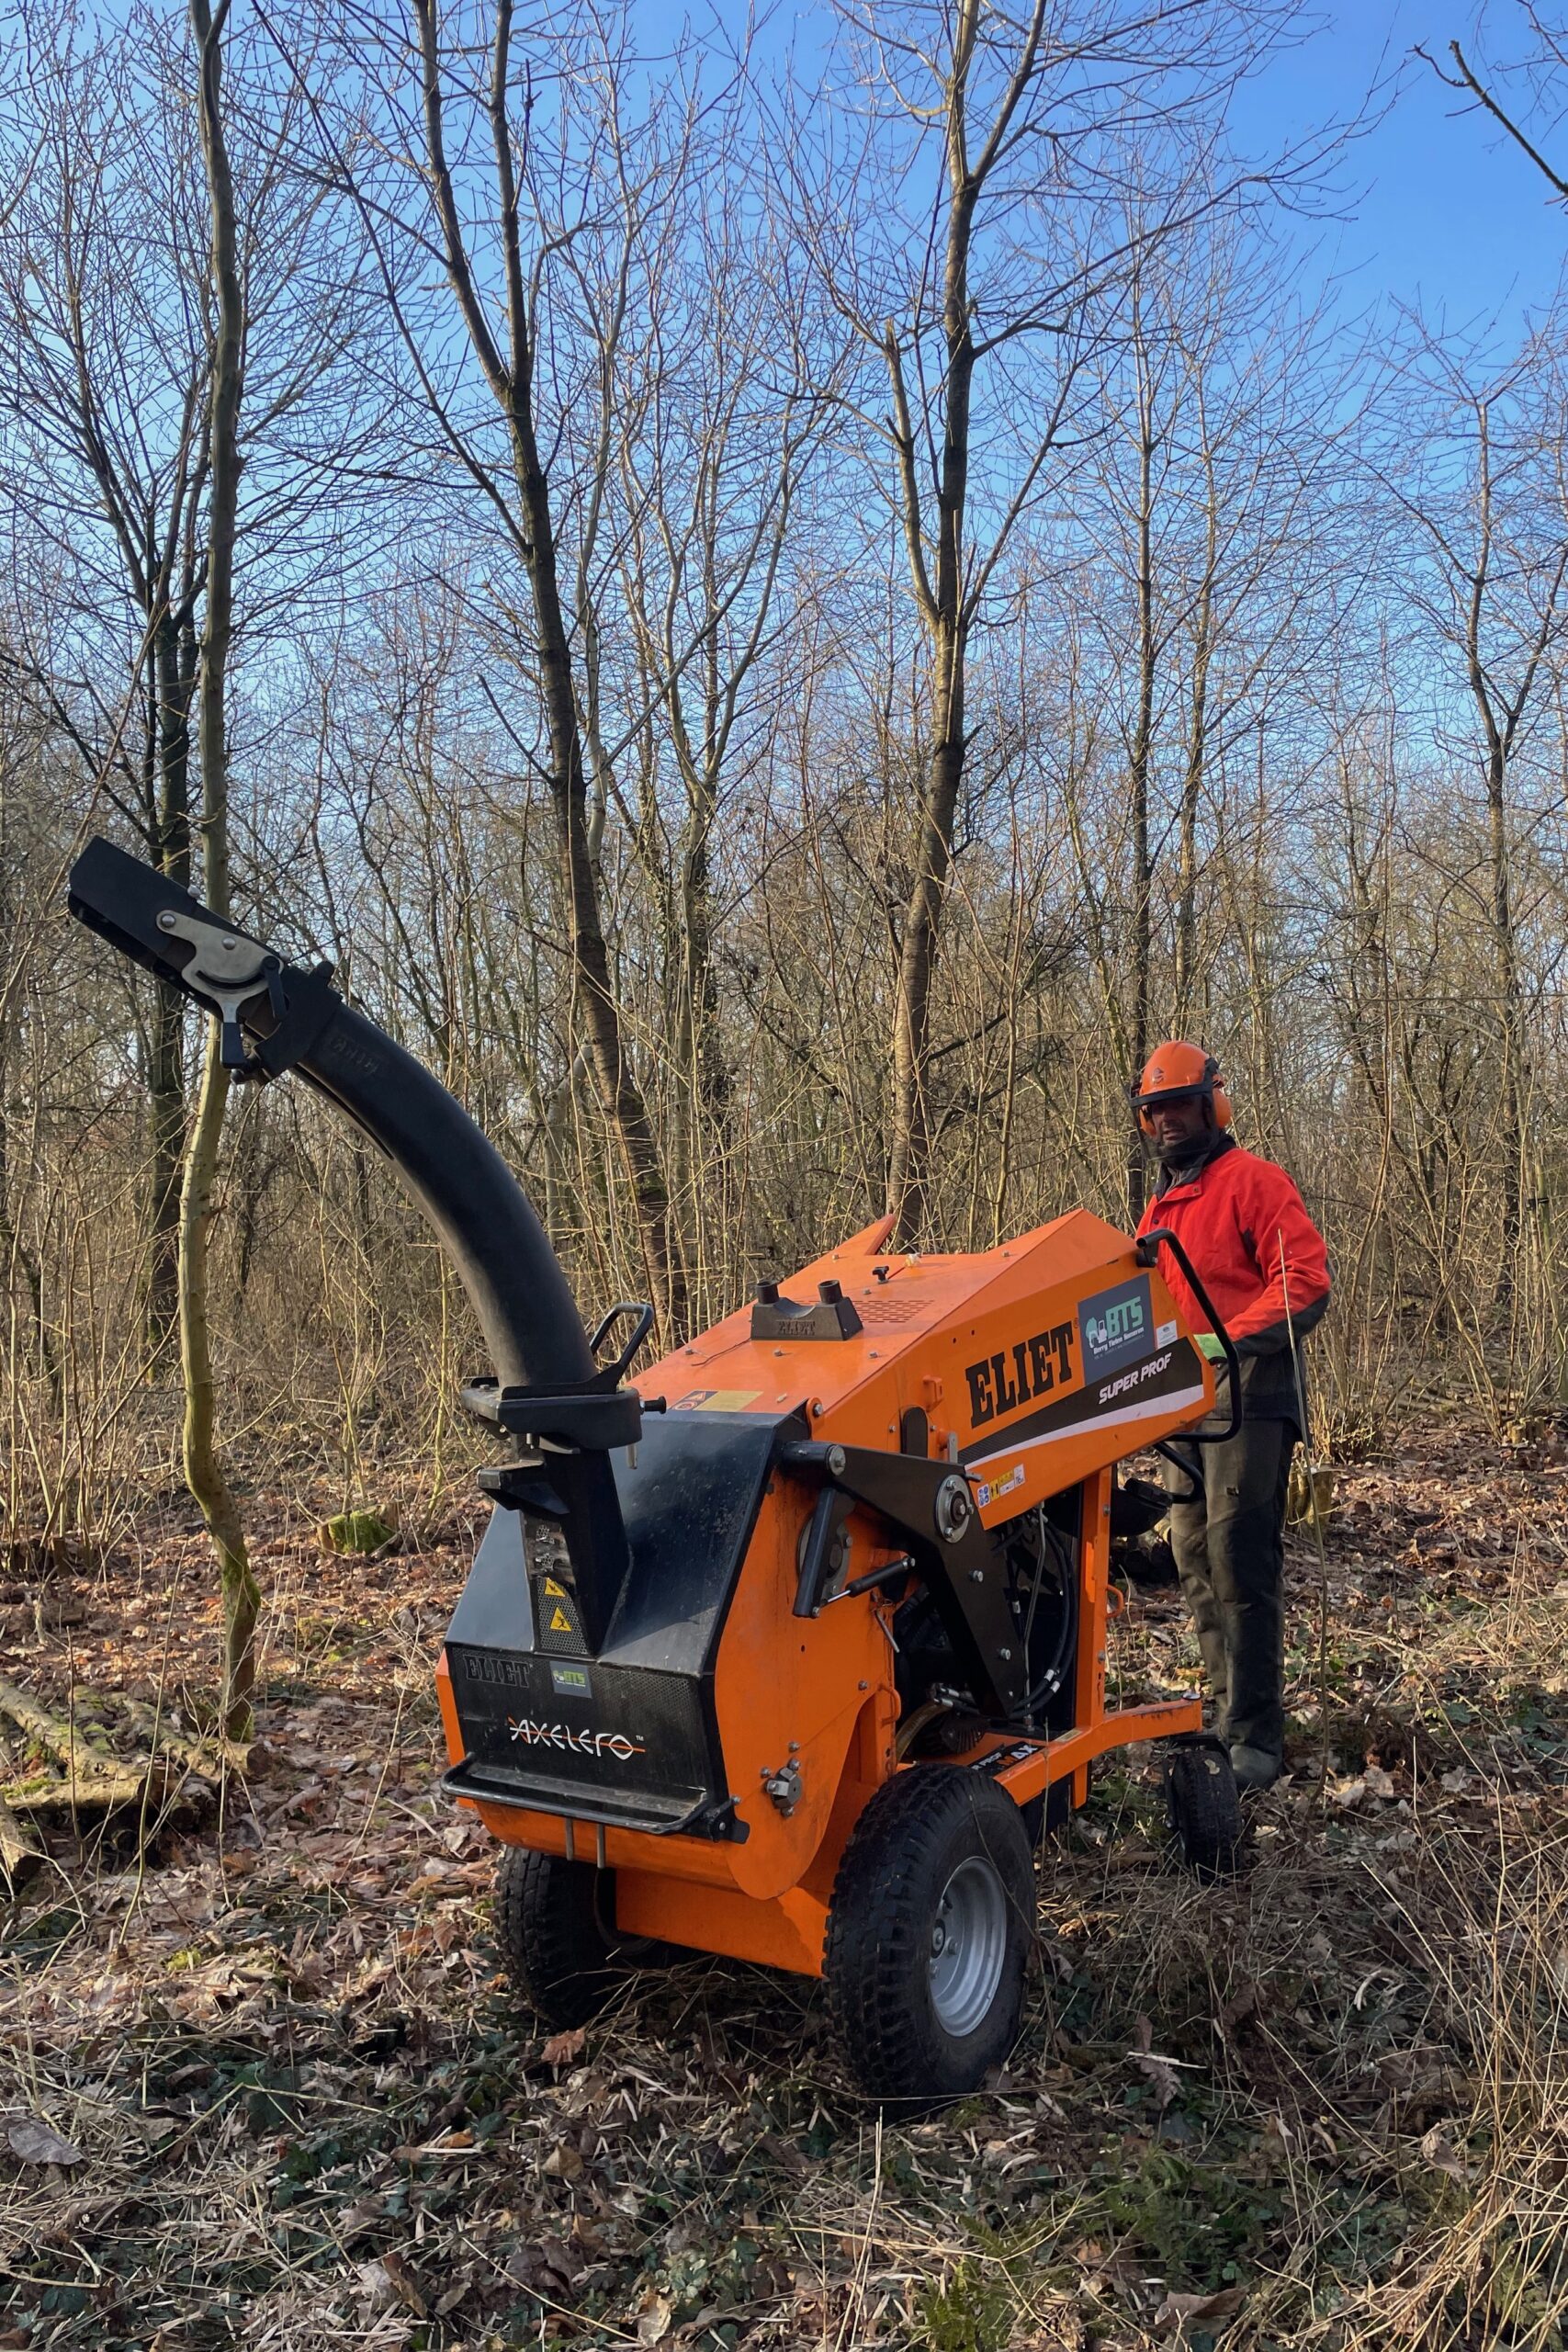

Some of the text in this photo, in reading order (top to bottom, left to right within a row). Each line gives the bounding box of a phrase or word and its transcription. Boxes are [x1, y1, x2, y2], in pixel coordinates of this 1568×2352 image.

[1105, 1296, 1144, 1340] BTS
[965, 1320, 1073, 1429] ELIET
[1099, 1352, 1172, 1405] SUPER PROF
[463, 1654, 530, 1689] ELIET
